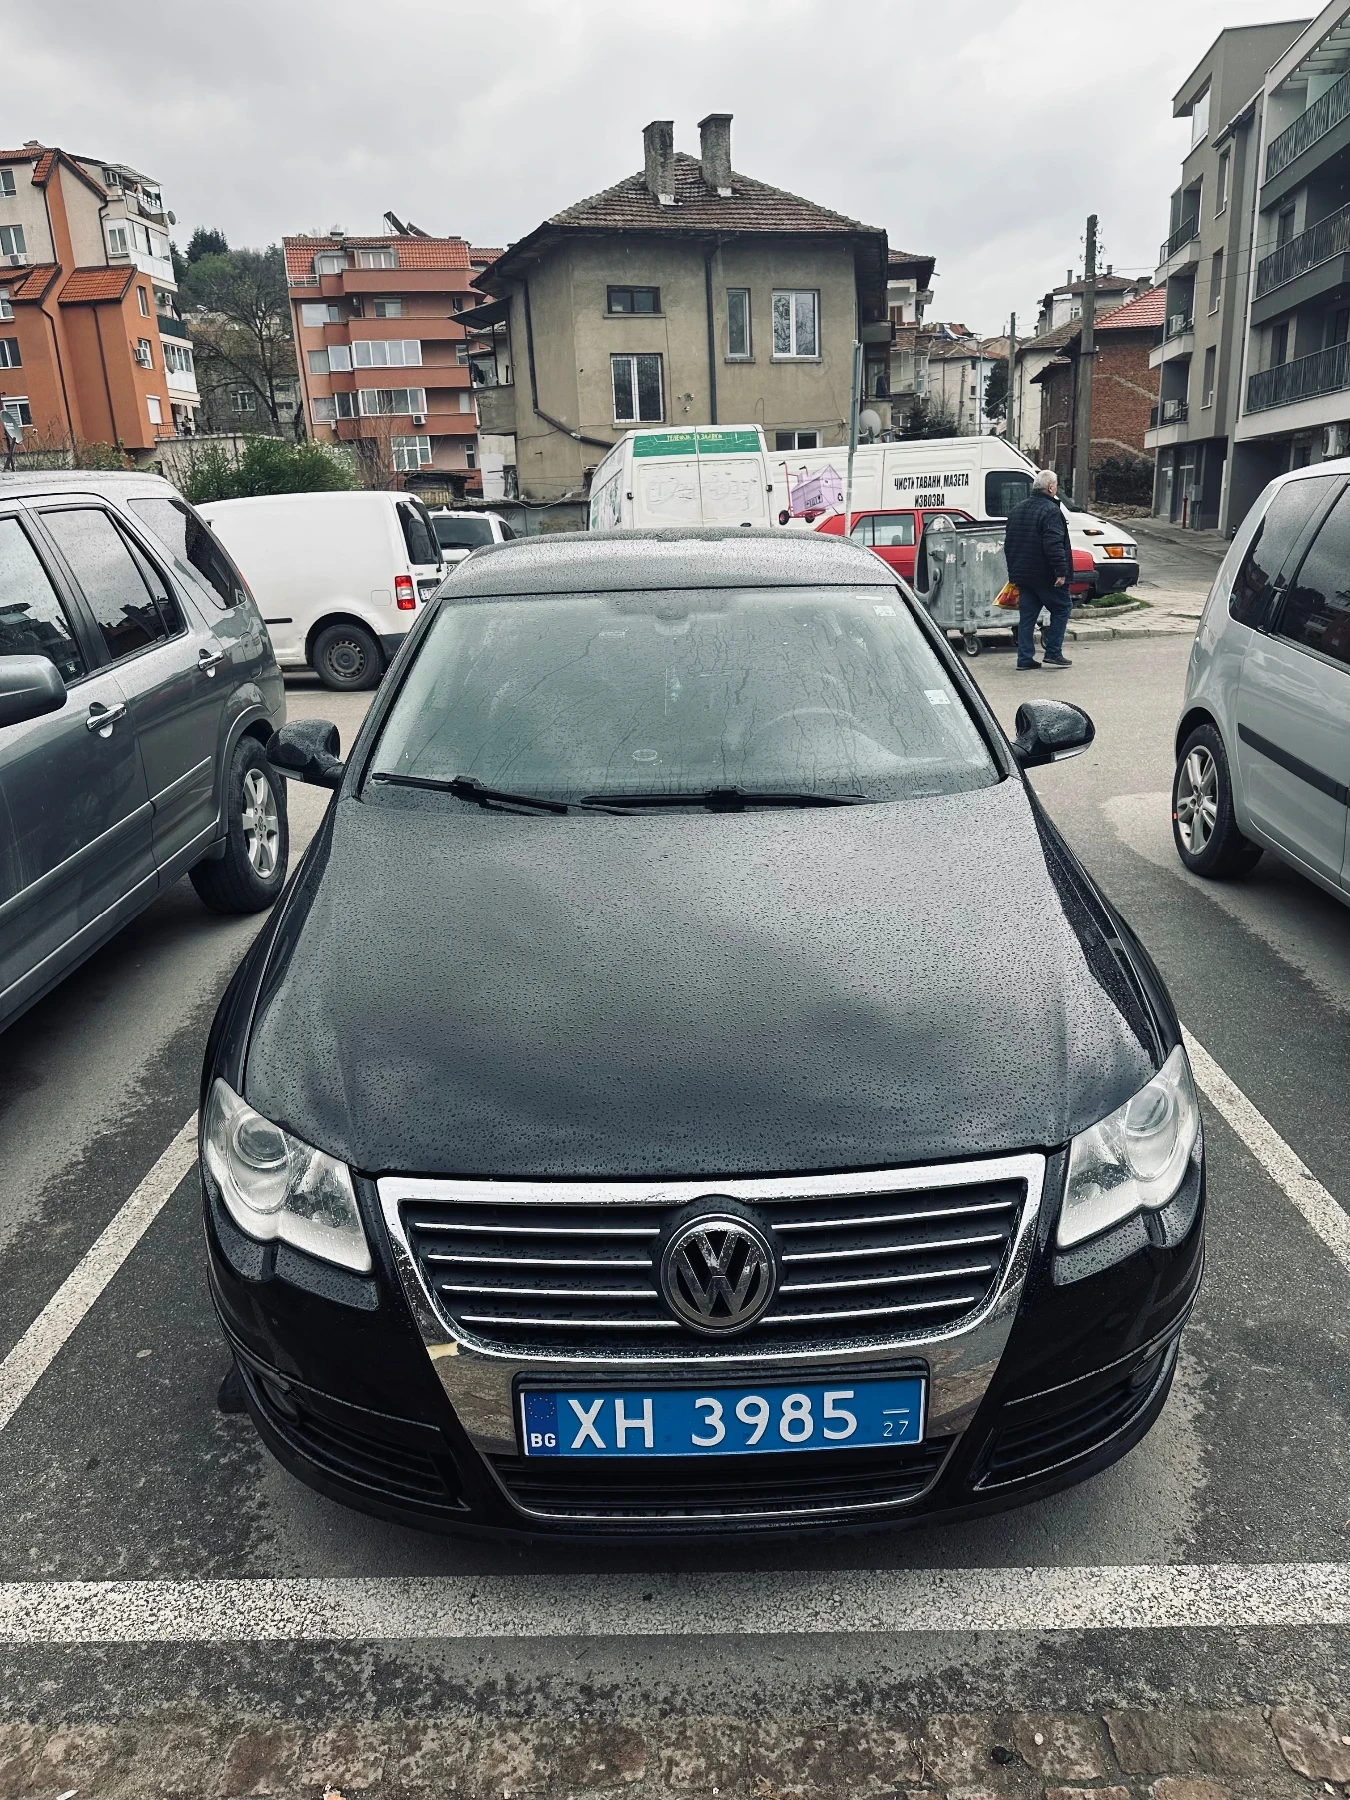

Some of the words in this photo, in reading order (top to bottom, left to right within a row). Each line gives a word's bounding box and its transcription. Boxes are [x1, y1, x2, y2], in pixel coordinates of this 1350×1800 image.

[894, 477, 914, 490] ЧИСТИ
[943, 473, 969, 487] МАЗЕТА
[914, 493, 945, 508] ИЗВОЗВА
[567, 1398, 654, 1449] XH
[691, 1390, 858, 1447] 3985
[882, 1420, 910, 1437] 27
[530, 1433, 556, 1448] BG
